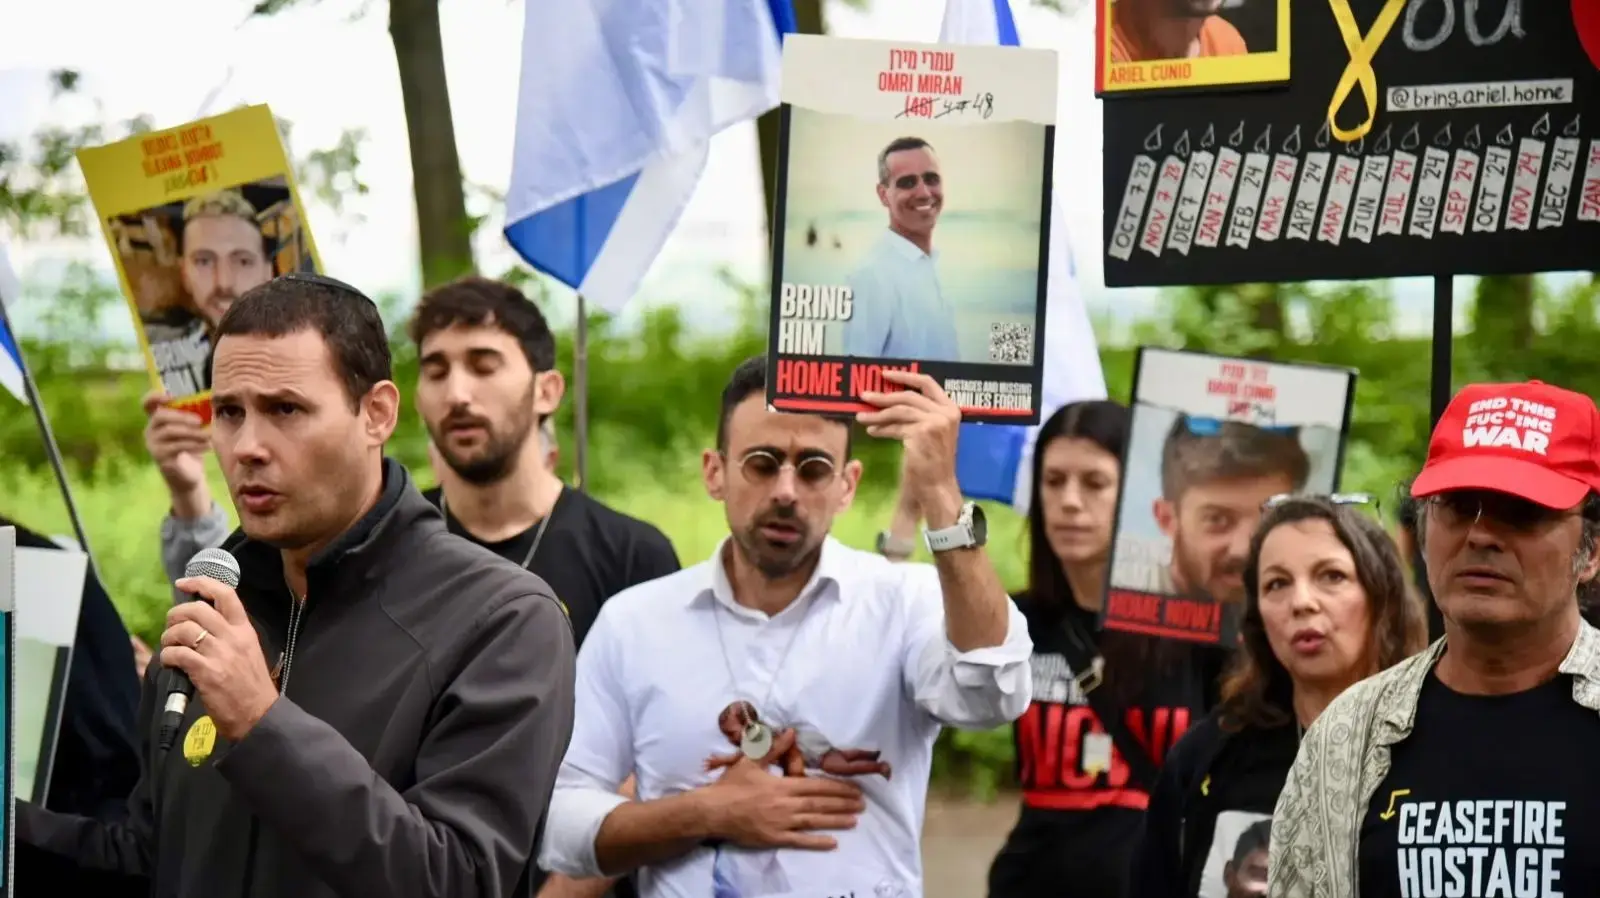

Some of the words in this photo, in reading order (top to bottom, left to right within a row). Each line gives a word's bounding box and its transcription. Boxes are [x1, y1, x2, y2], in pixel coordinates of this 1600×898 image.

[889, 49, 917, 70] מירן
[921, 50, 954, 71] עמרי
[1109, 66, 1145, 84] ARIEL
[1150, 63, 1192, 82] CUNIO
[878, 72, 913, 93] OMRI
[917, 74, 962, 96] MIRAN
[1391, 85, 1567, 109] @bring.ariel.home
[972, 92, 994, 120] 48
[1182, 196, 1198, 206] 7
[1208, 191, 1226, 205] 7
[1260, 196, 1285, 236] MAR
[1353, 197, 1376, 234] JUN
[1382, 192, 1406, 226] JUL
[1412, 195, 1437, 233] AUG
[1444, 190, 1468, 225] SEP
[1476, 187, 1499, 227] OCT
[1509, 185, 1532, 225] NOV
[1540, 181, 1568, 222] DEC
[1115, 206, 1139, 249] OCT
[1130, 184, 1146, 196] 7
[1144, 208, 1168, 248] NOV
[1156, 190, 1172, 202] 7
[1172, 210, 1195, 244] DEC
[1200, 208, 1224, 242] JAN
[1230, 205, 1254, 241] FEB
[1291, 199, 1315, 235] APR
[1322, 201, 1345, 239] MAY
[780, 282, 853, 321] BRING
[778, 319, 825, 356] HIM
[776, 359, 844, 397] HOME
[993, 392, 1032, 411] FORUM
[1469, 397, 1507, 415] END
[1510, 397, 1556, 420] THIS
[1463, 426, 1550, 456] WAR
[1107, 589, 1160, 623] HOME
[1164, 598, 1220, 634] NOW!
[1398, 800, 1567, 845] CEASEFIRE
[1397, 847, 1566, 898] HOSTAGE
